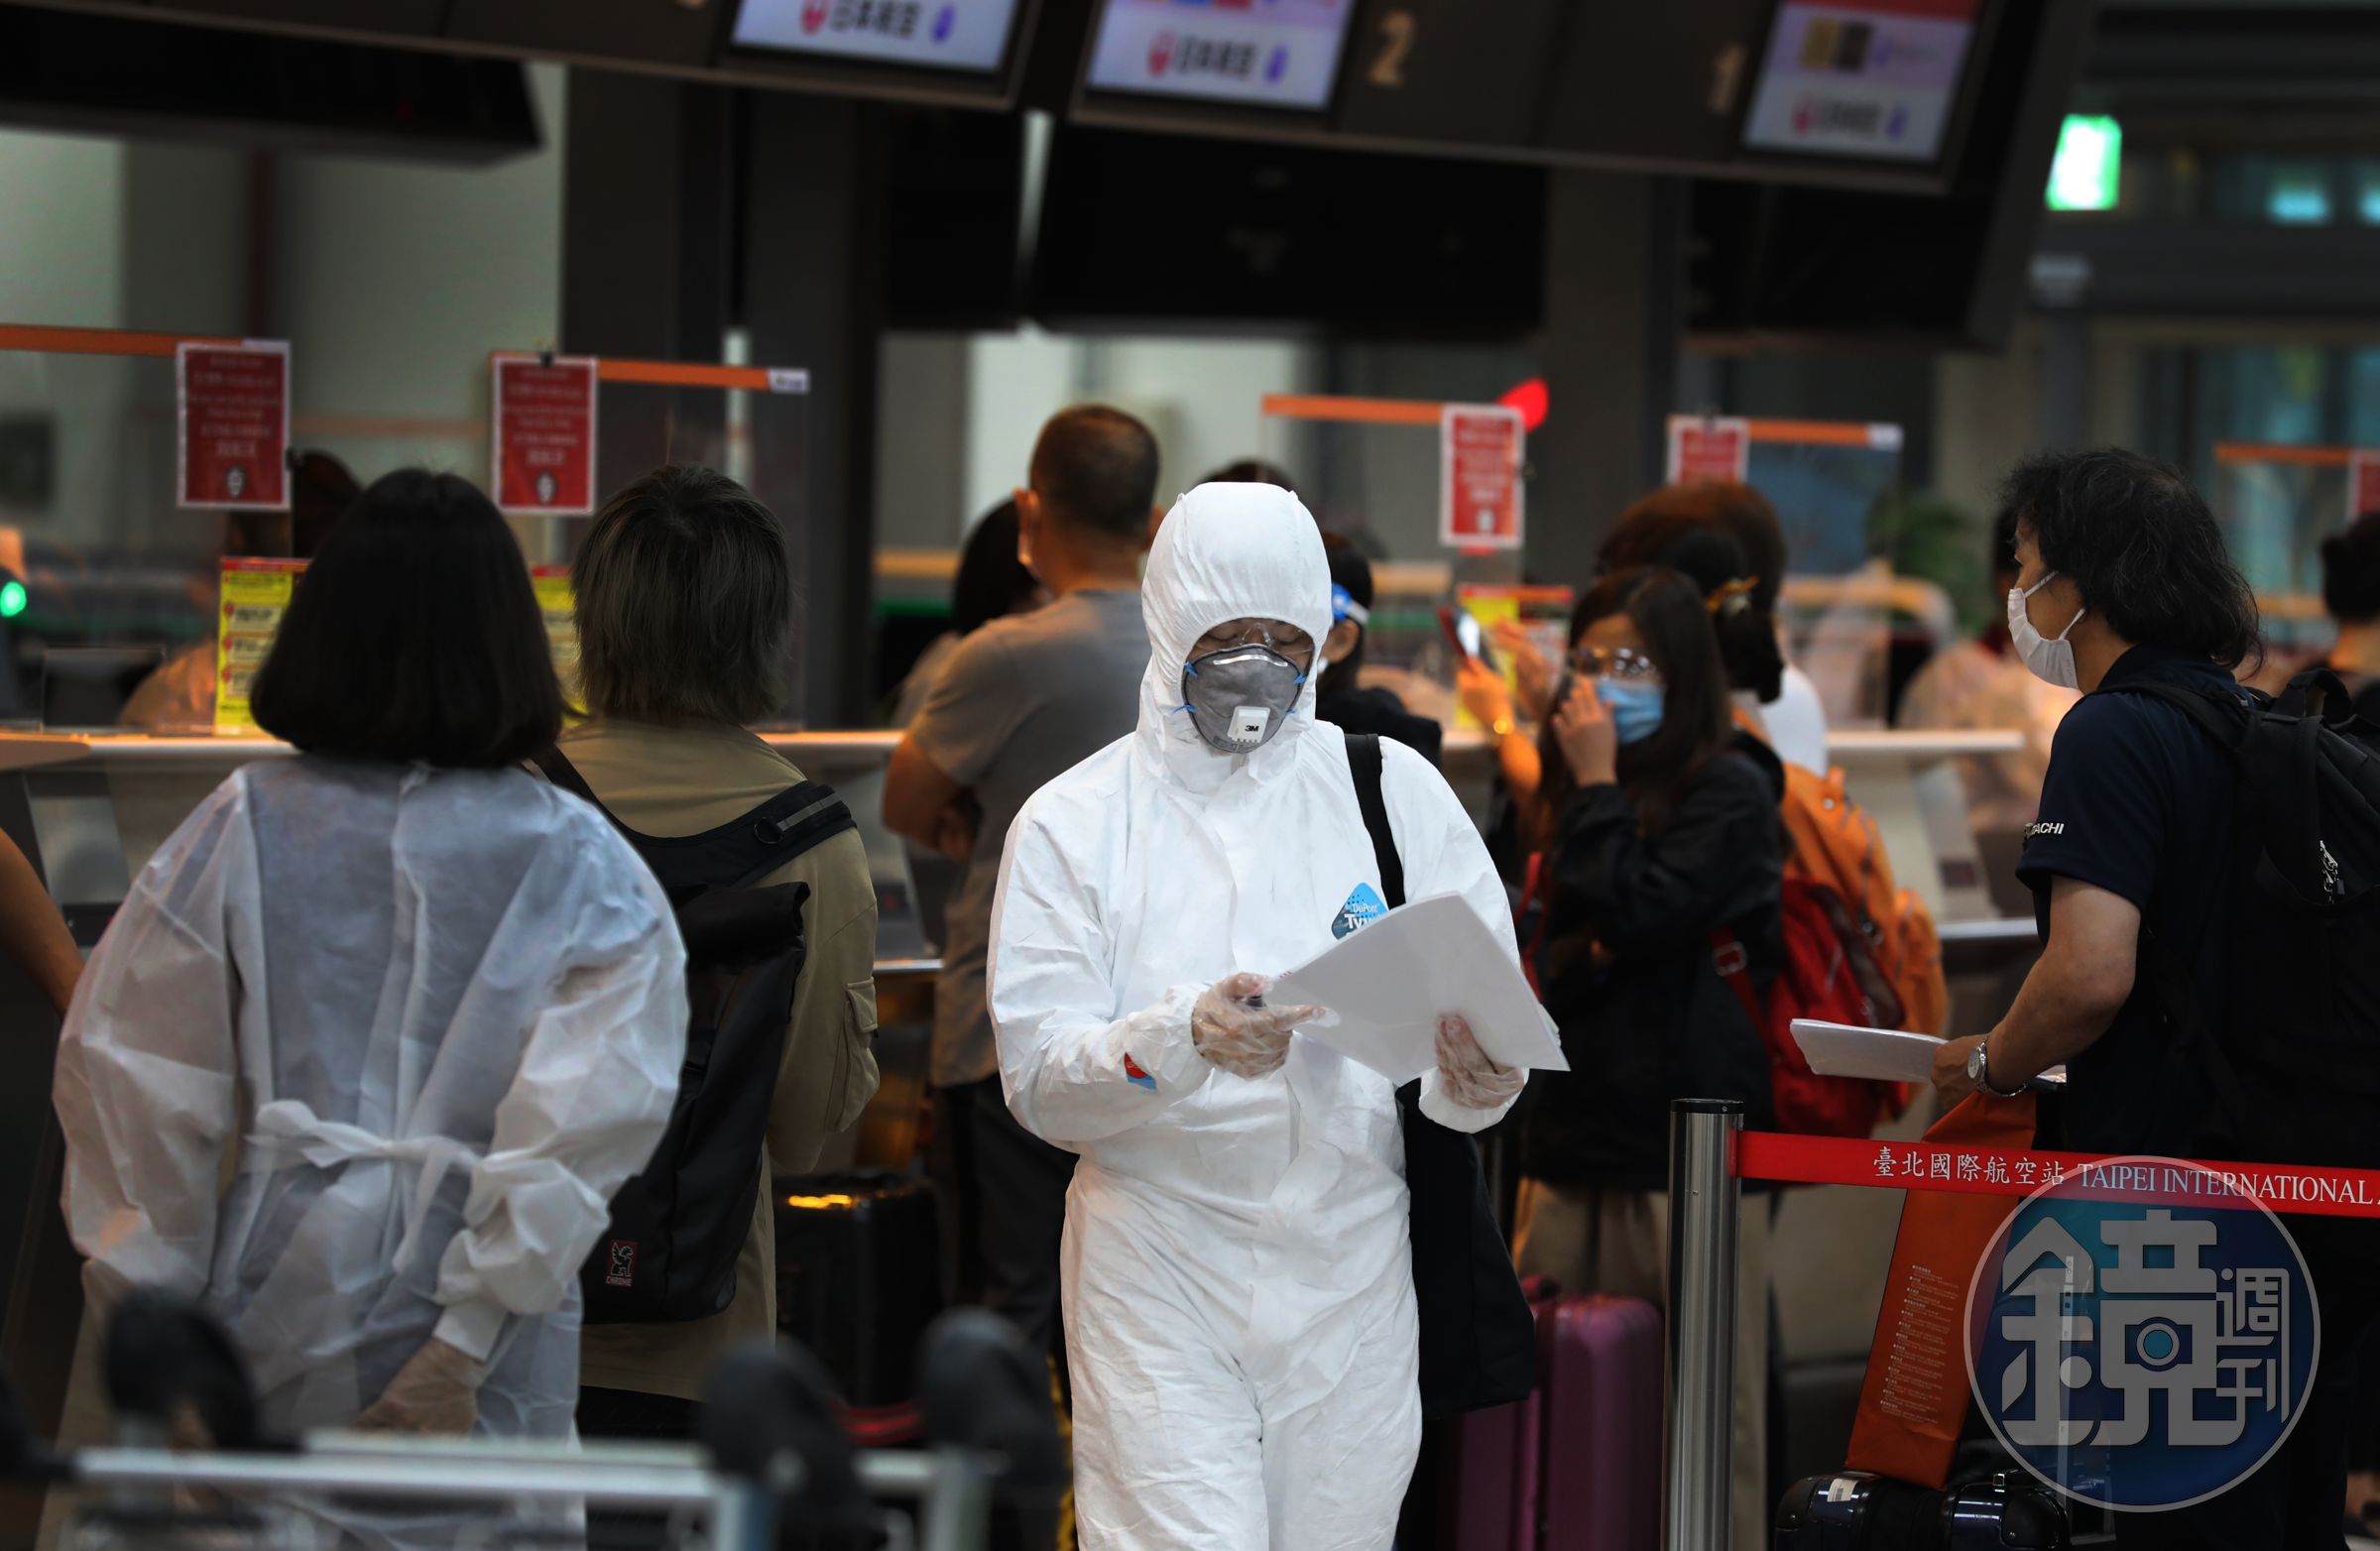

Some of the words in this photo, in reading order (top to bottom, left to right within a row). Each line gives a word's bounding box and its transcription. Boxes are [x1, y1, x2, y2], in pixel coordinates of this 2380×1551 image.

[1368, 12, 1415, 85] 2
[1873, 1145, 2065, 1186] 臺北國際航空站
[2078, 1163, 2157, 1192] TAIPEI
[2163, 1168, 2374, 1205] INTERNATIONAL
